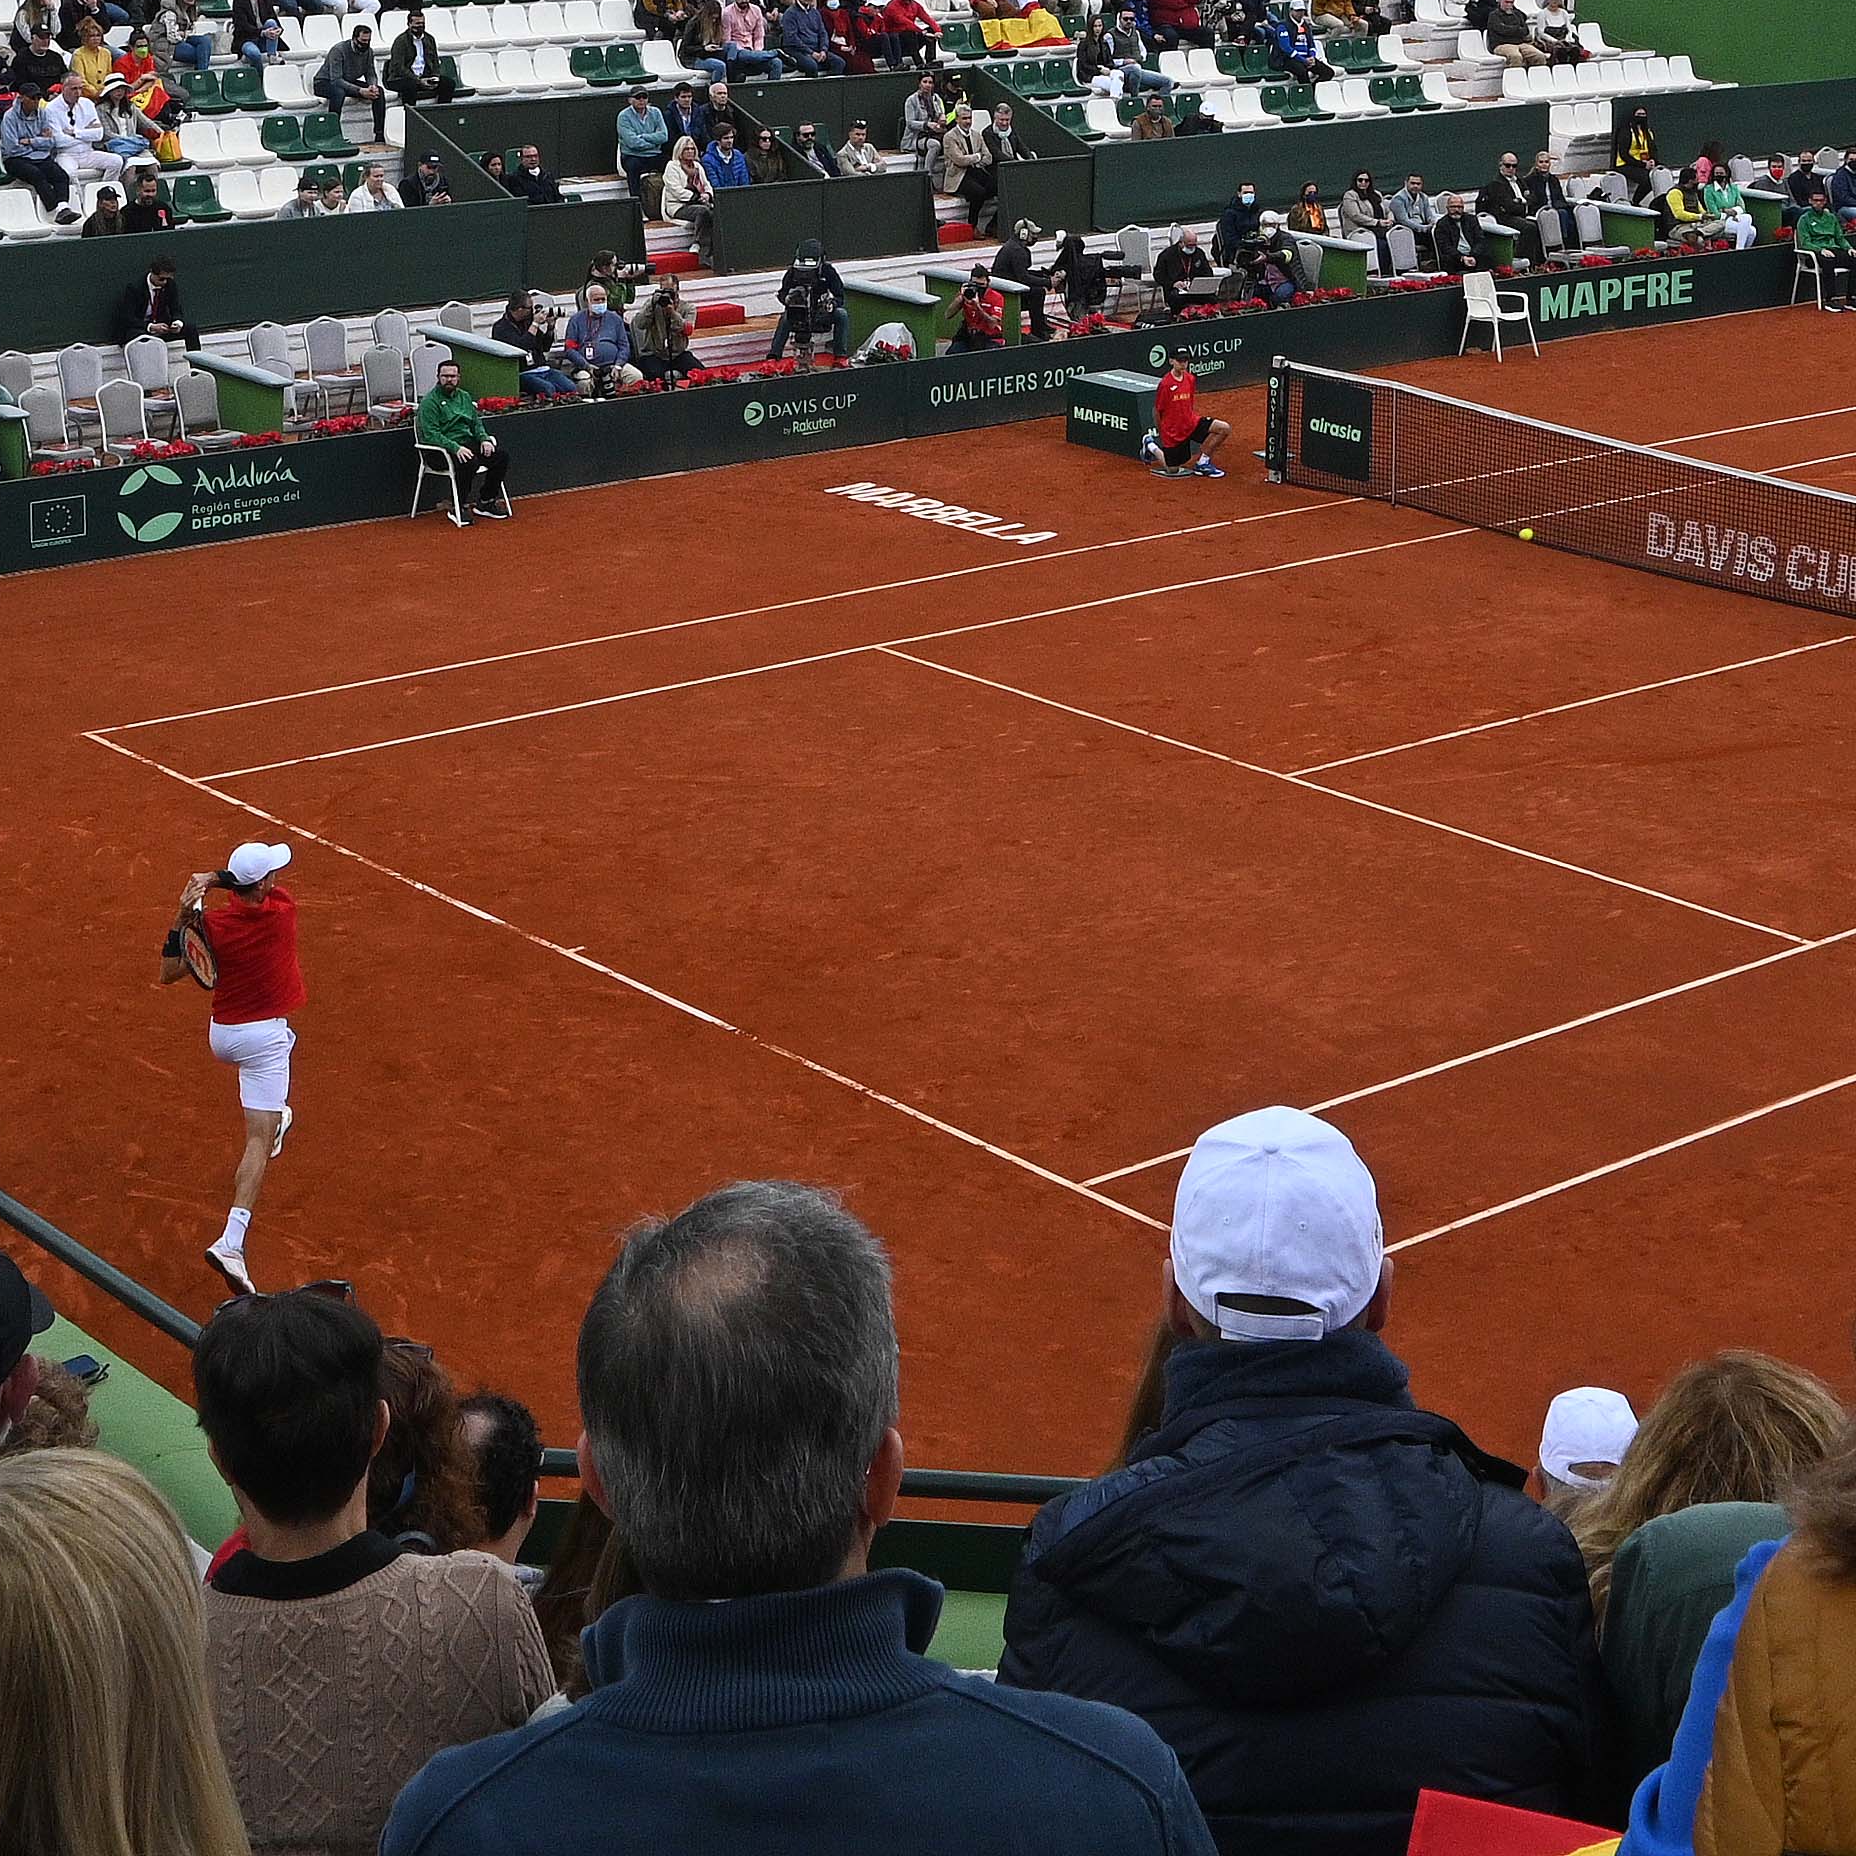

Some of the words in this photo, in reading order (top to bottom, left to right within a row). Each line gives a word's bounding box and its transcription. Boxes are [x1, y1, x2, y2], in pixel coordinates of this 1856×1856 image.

[1540, 268, 1696, 322] MAPFRE
[1188, 342, 1210, 357] VIS
[1213, 338, 1243, 354] CUP
[1189, 359, 1225, 373] Rakuten
[930, 372, 1037, 407] QUALIFIERS
[768, 398, 818, 419] DAVIS
[822, 393, 858, 411] CUP
[1073, 405, 1129, 431] MAPFRE
[792, 415, 836, 434] Rakuten
[1309, 417, 1362, 443] airasia
[192, 456, 300, 495] Andalucía
[191, 500, 231, 515] Región
[234, 496, 280, 512] Europea
[283, 489, 301, 502] del
[824, 481, 1058, 545] MARBELLA
[192, 510, 262, 530] DEPORTE
[1645, 511, 1777, 583] DAVIS
